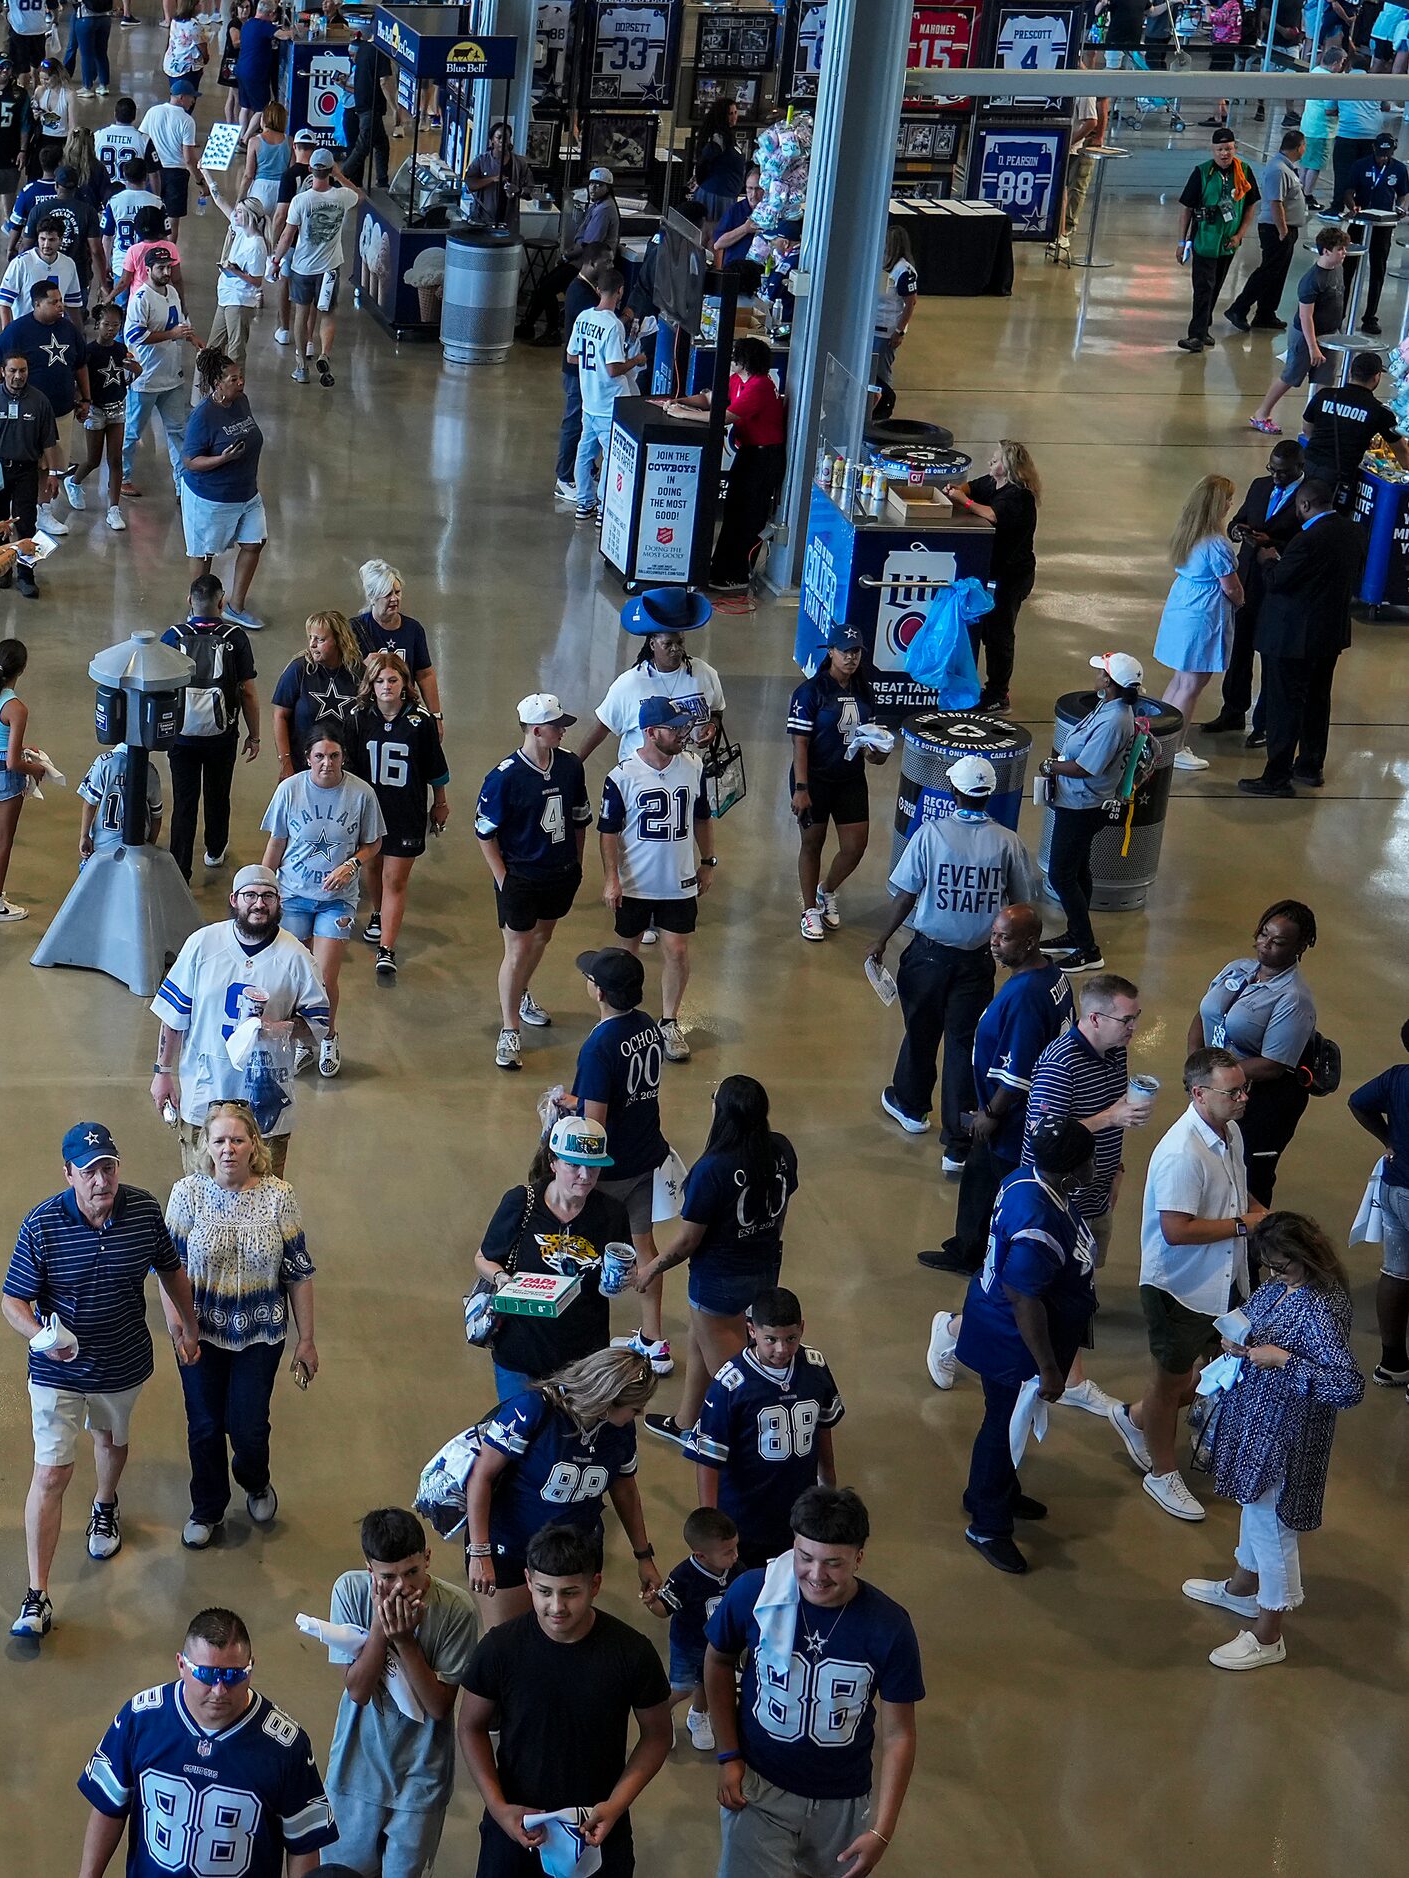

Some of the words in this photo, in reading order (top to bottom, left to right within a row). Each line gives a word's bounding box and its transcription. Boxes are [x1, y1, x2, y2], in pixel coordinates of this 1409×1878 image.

[615, 22, 651, 33] DORSETT
[919, 24, 956, 35] MAHOMES
[1014, 29, 1052, 40] PRESCOTT
[610, 37, 650, 71] 33
[919, 39, 952, 69] 15
[1020, 45, 1038, 69] 4
[446, 63, 465, 73] Blue
[106, 134, 132, 145] WITTEN
[1006, 156, 1039, 167] PEARSON
[997, 171, 1035, 205] 88
[1321, 400, 1368, 422] VENDOR
[656, 451, 674, 461] JOIN
[675, 452, 690, 461] THE
[647, 463, 697, 474] COWBOYS
[666, 475, 676, 485] IN
[650, 498, 665, 507] THE
[666, 499, 688, 509] MOST
[657, 487, 682, 497] DOING
[655, 510, 680, 521] GOOD!
[804, 544, 838, 617] COLDER
[804, 587, 818, 627] THAN
[818, 608, 831, 640] ICE
[836, 702, 861, 745] 4
[948, 712, 995, 723] BOTTLES
[921, 742, 947, 755] BOTTLES
[948, 750, 968, 758] ONLY
[952, 741, 998, 750] BOTTLES
[366, 740, 410, 787] 16
[290, 804, 359, 835] DALLAS
[540, 795, 566, 843] 4
[636, 785, 691, 842] 21
[923, 805, 937, 815] THE
[937, 863, 1002, 890] EVENT
[936, 888, 1000, 913] STAFF
[620, 1026, 661, 1057] OCHOA
[626, 1043, 662, 1095] 00
[522, 1277, 557, 1286] PAPA
[757, 1399, 821, 1461] 88
[540, 1462, 609, 1503] 88
[752, 1649, 876, 1748] 88
[183, 1763, 219, 1779] COWBOYS
[140, 1767, 262, 1878] 88
